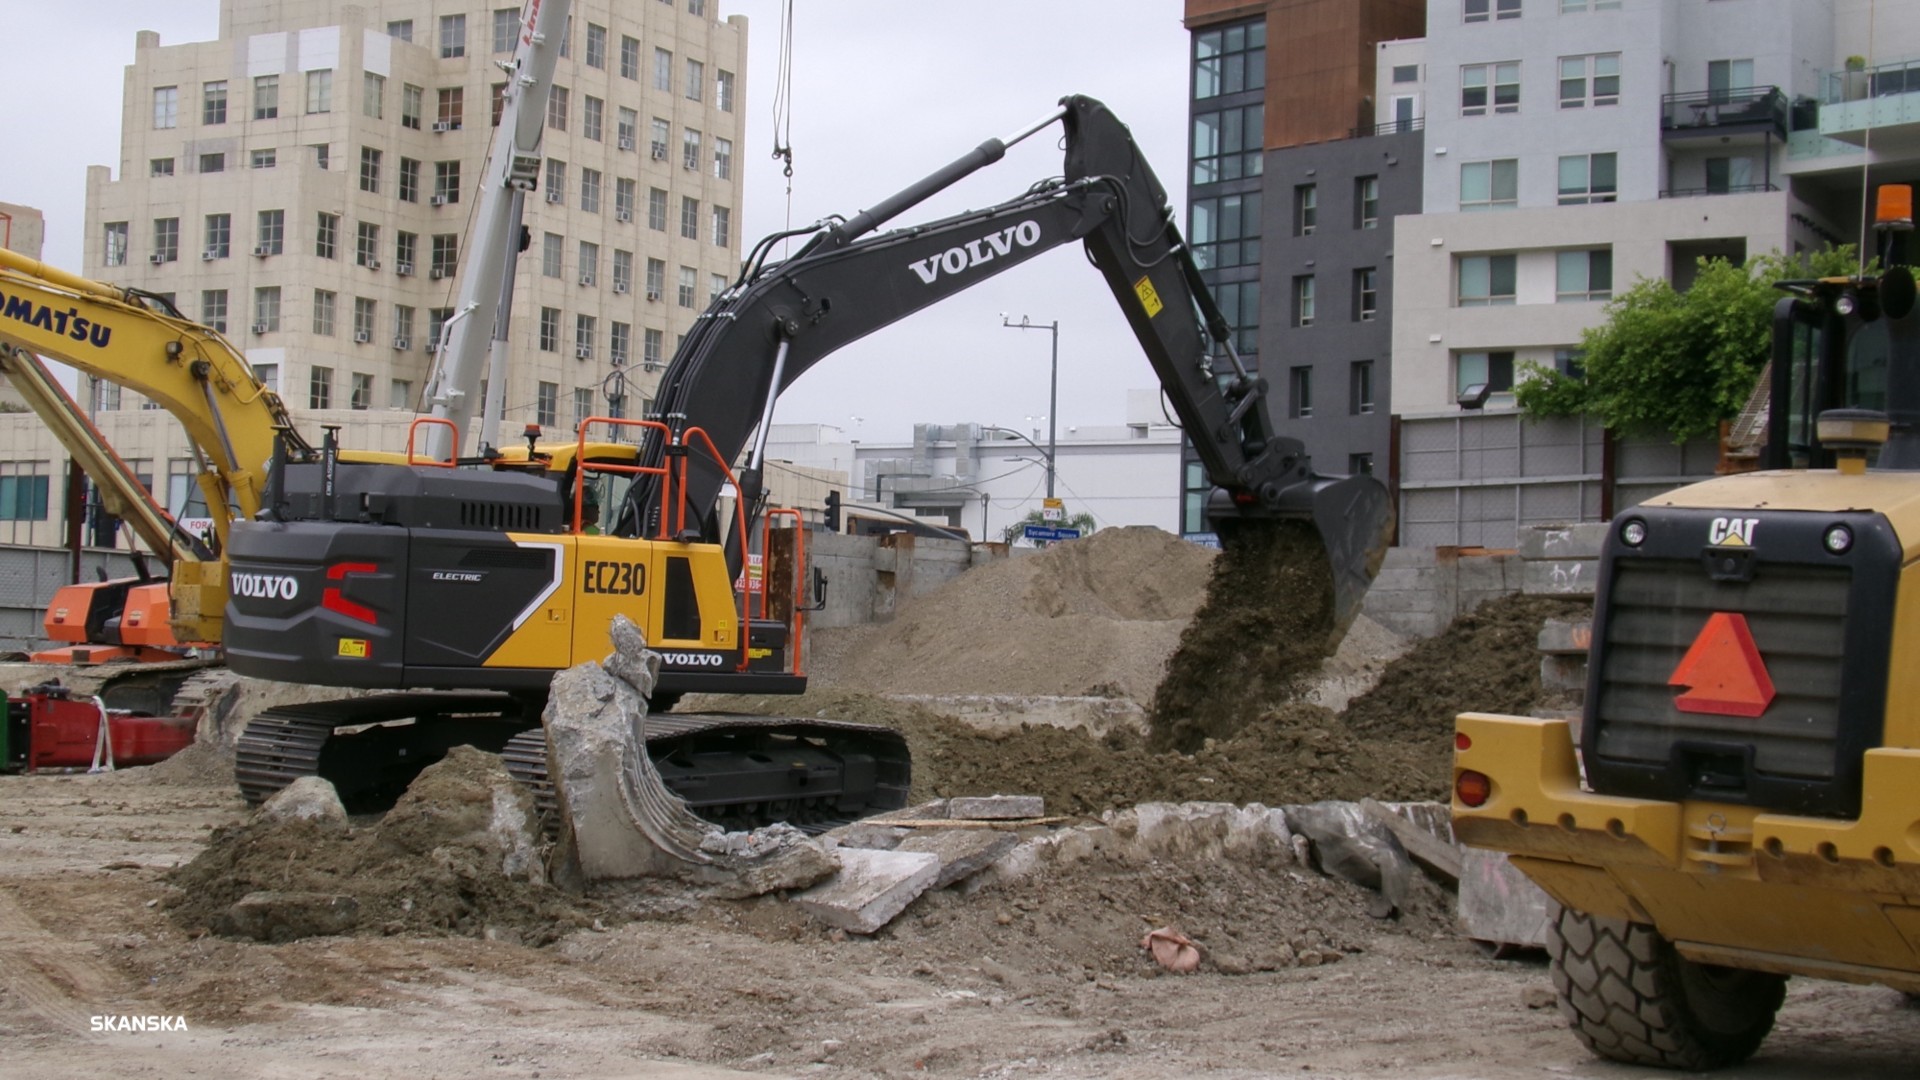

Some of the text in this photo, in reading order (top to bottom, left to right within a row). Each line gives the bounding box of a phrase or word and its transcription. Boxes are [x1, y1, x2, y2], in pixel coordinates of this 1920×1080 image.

[909, 220, 1041, 284] VOLVO
[0, 290, 111, 348] MATSU
[190, 521, 208, 529] FOR
[1028, 529, 1056, 538] Sycamore
[1709, 517, 1760, 546] CAT
[231, 573, 298, 600] VOLVO
[432, 572, 482, 582] ELECTRIC
[584, 561, 646, 596] EC230
[662, 653, 723, 666] VOLVO
